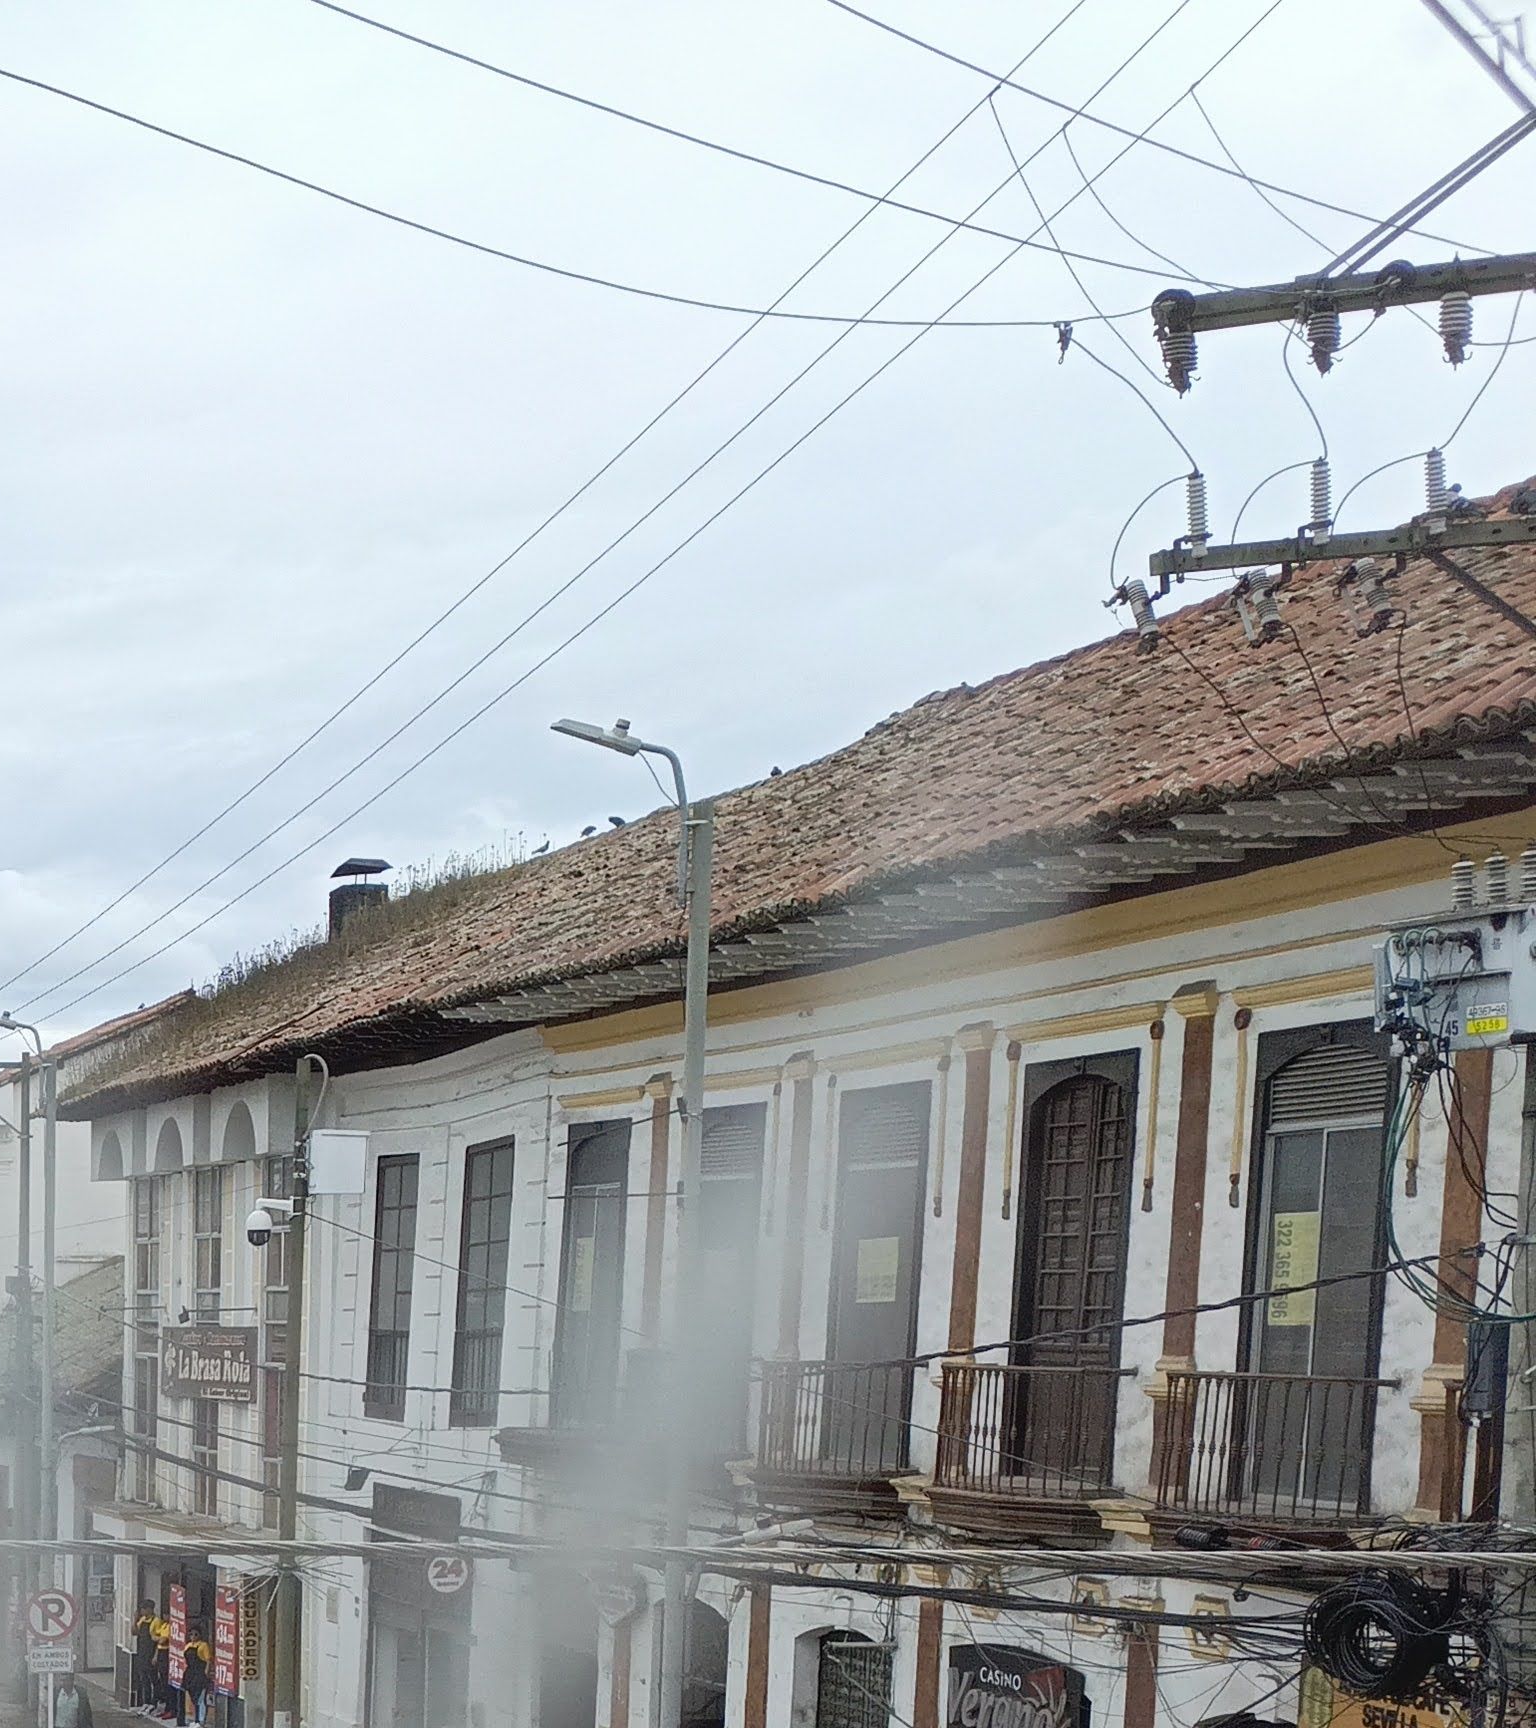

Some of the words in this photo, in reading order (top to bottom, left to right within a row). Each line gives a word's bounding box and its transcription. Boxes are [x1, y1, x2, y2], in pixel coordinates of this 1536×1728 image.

[1277, 1220, 1293, 1247] 322
[1275, 1251, 1291, 1278] 365
[191, 1350, 221, 1381] Brasa
[432, 1560, 464, 1579] 24
[979, 1666, 1022, 1691] CASINO
